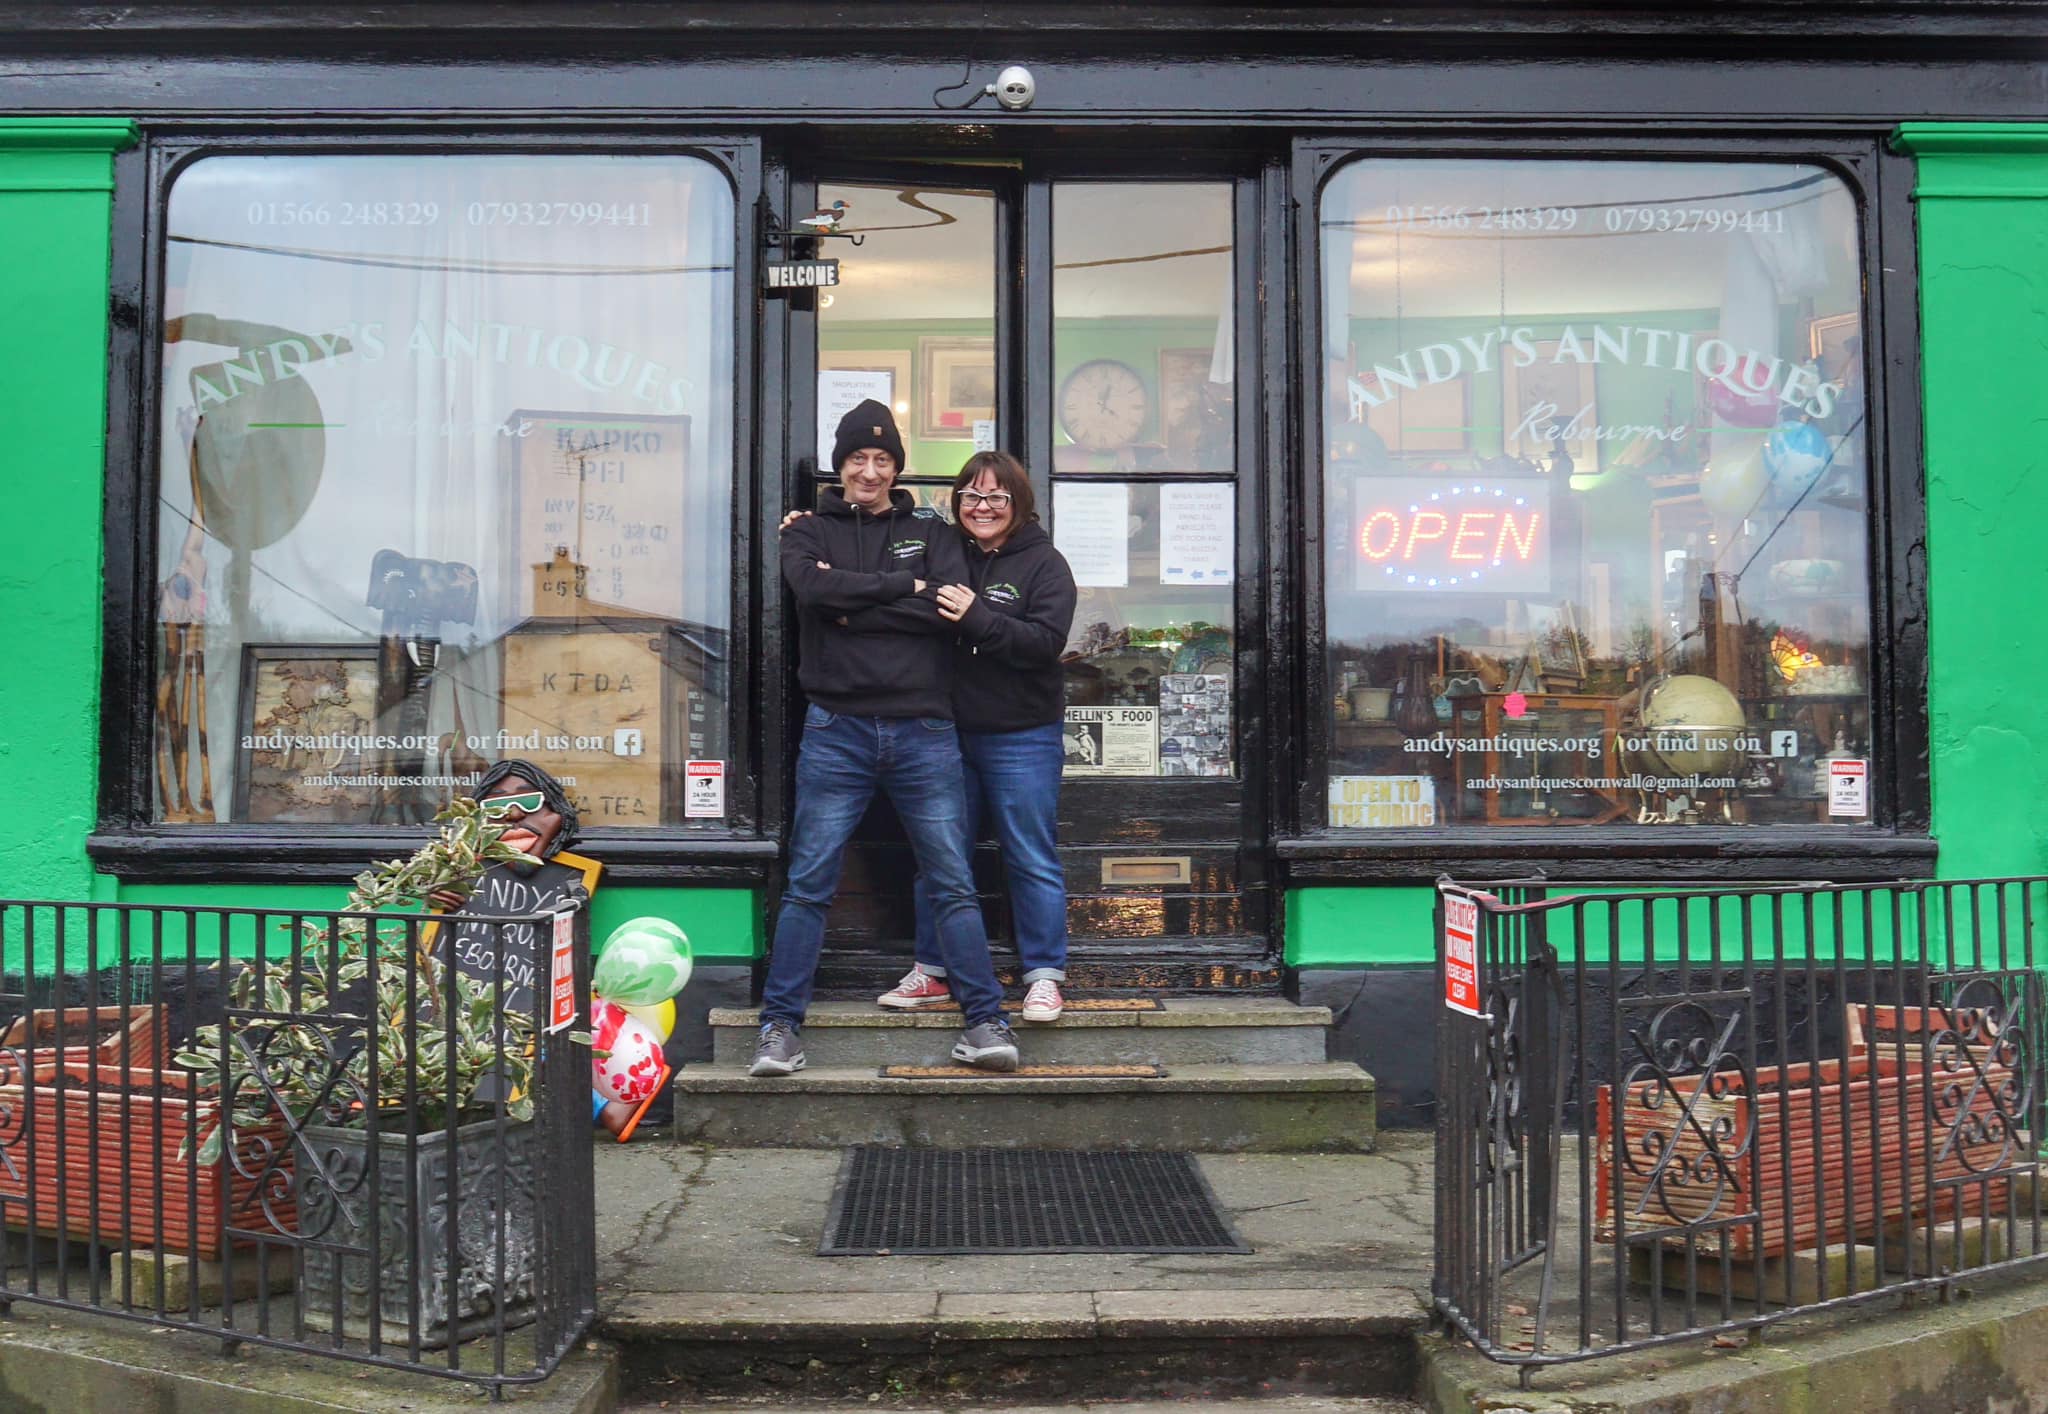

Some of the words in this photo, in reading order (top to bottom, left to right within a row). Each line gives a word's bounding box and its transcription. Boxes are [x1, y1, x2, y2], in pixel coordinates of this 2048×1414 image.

[247, 201, 331, 226] 01566
[340, 201, 440, 226] 248329
[467, 201, 651, 226] 07932799441
[1386, 205, 1470, 230] 01566
[1478, 206, 1578, 231] 248329
[1605, 207, 1785, 233] 07932799441
[768, 266, 834, 287] WELCOME
[194, 321, 385, 416] ANDY'S
[408, 319, 694, 414] ANTIQUES
[1346, 325, 1537, 422] ANDY'S
[1553, 324, 1842, 419] ANTIQUES
[1509, 399, 1688, 442] Rebourne
[1359, 511, 1540, 560] OPEN
[1122, 710, 1153, 722] FOOD
[242, 729, 440, 759] andysantiques.org
[466, 735, 491, 750] or
[495, 729, 541, 750] find
[545, 735, 569, 751] us
[575, 735, 603, 750] on
[1403, 732, 1601, 760] andysantiques.org
[1626, 736, 1651, 752] or
[1656, 731, 1700, 753] find
[1705, 737, 1728, 753] us
[1734, 737, 1762, 753] on
[1466, 773, 1736, 793] andysantiquescornwall@gmail.com
[600, 796, 647, 816] TEA
